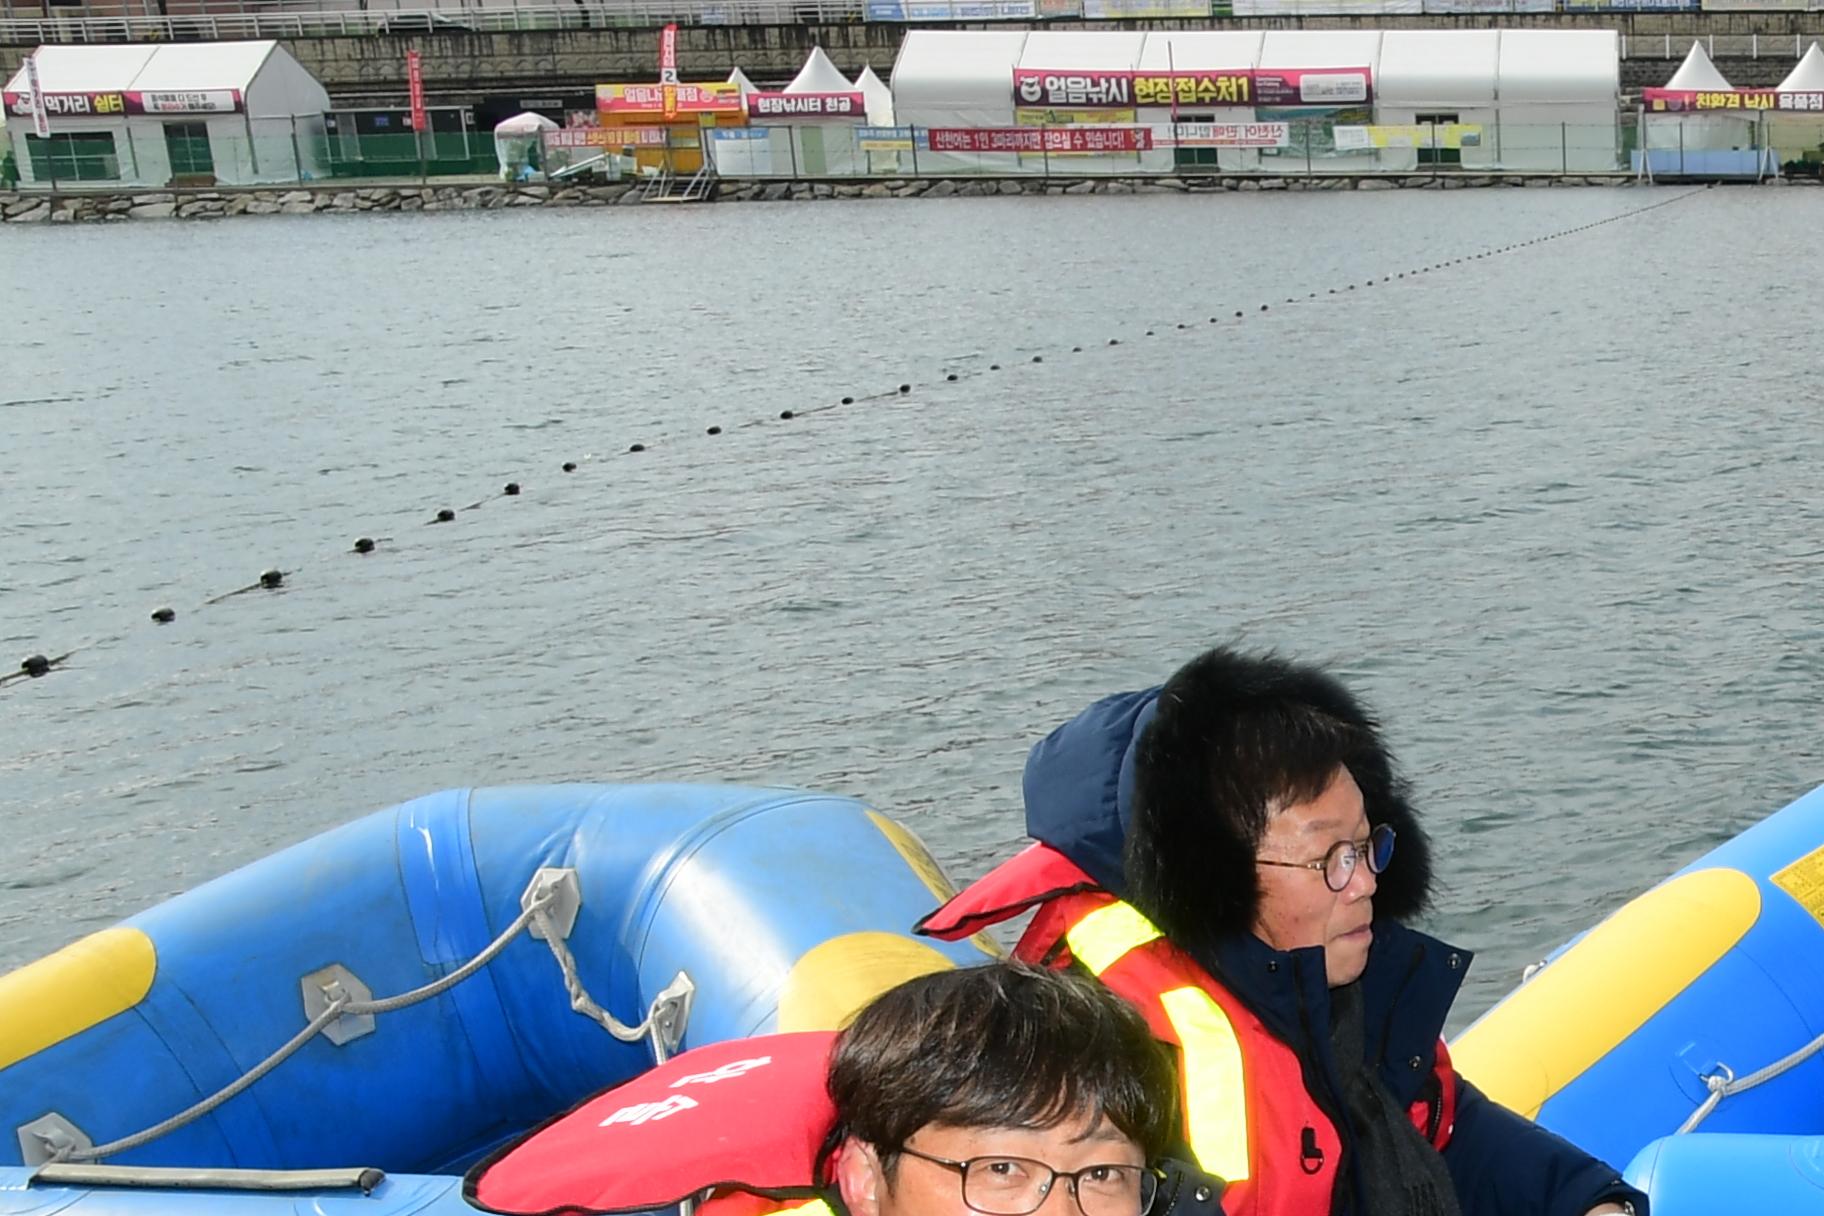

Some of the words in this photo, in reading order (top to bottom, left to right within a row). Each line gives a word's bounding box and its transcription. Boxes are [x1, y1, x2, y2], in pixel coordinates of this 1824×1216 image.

[664, 70, 674, 83] 2
[1045, 76, 1129, 104] 얼음낚시
[43, 95, 90, 114] 먹거리
[94, 94, 125, 113] 쉼터
[757, 97, 822, 114] 현장낚시터
[1744, 93, 1775, 109] 낚시
[935, 131, 971, 150] 산천어는
[973, 132, 989, 150] 1인
[1044, 130, 1072, 150] 잡으실
[1073, 131, 1083, 149] 수
[1085, 131, 1125, 149] 있습니다!
